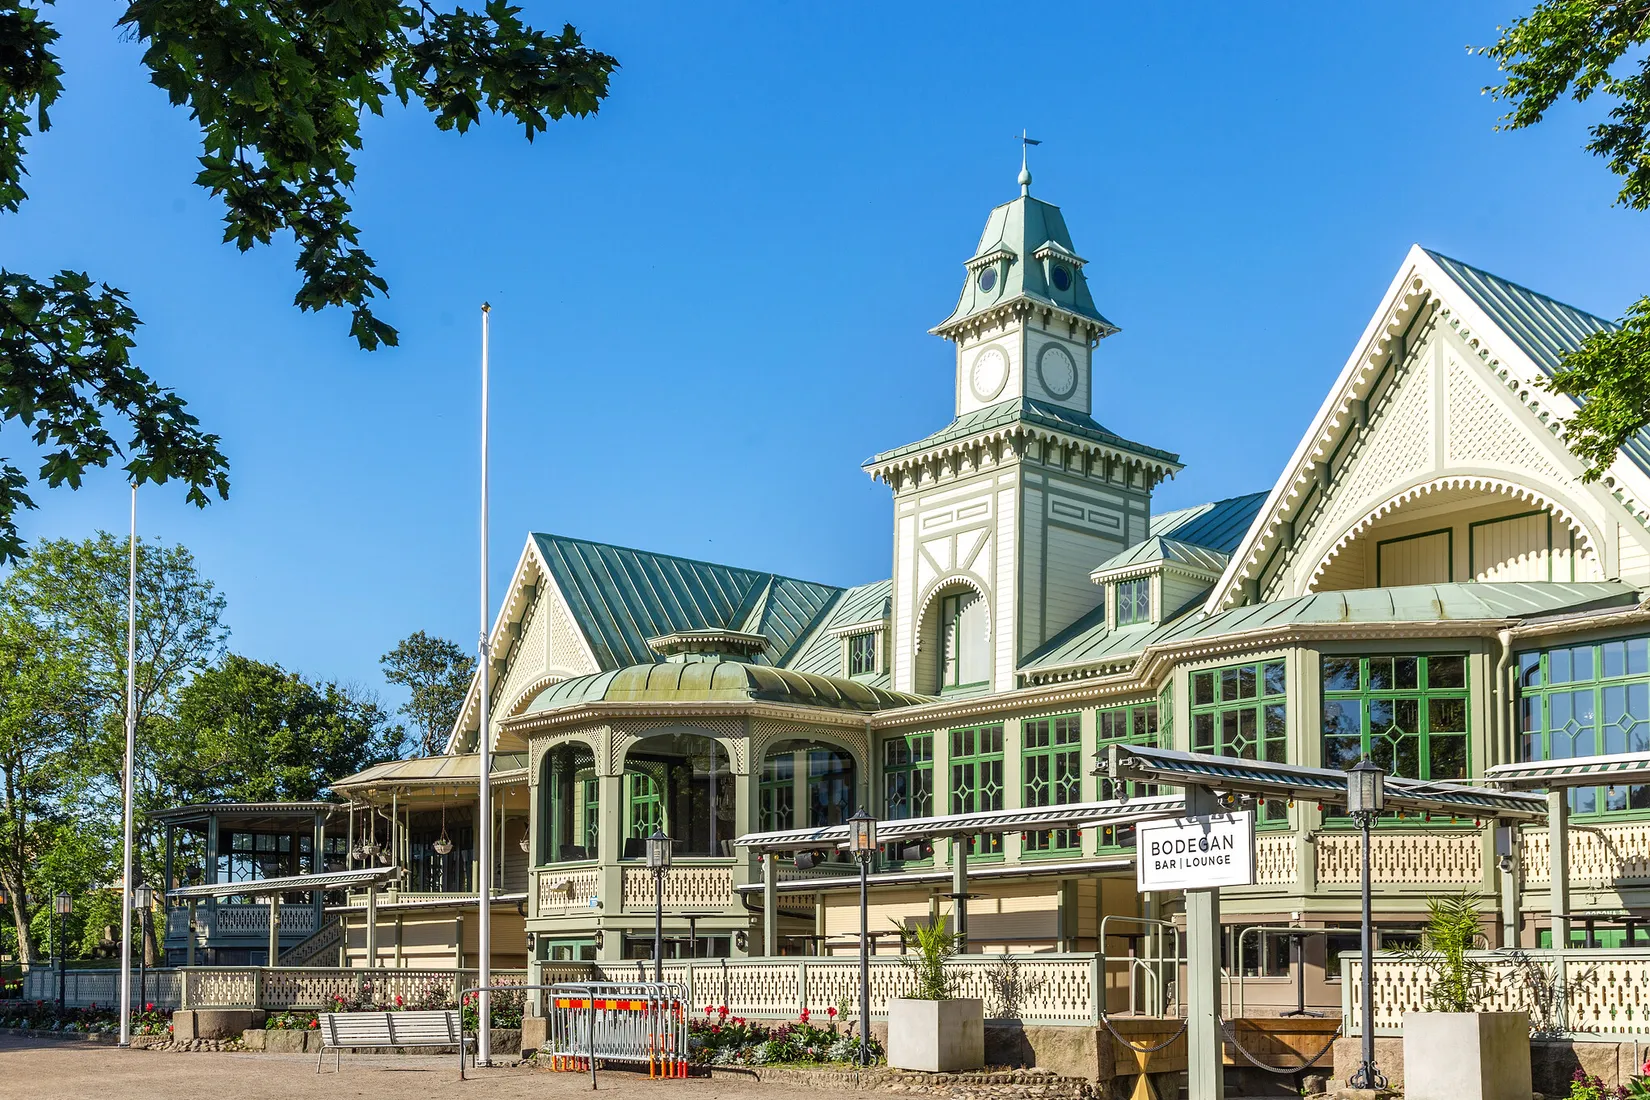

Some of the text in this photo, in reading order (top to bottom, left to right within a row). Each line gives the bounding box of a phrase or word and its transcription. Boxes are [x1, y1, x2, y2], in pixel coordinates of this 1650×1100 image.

[1151, 834, 1234, 857] BODEGAN
[1155, 854, 1231, 870] BAR LOUNGE
